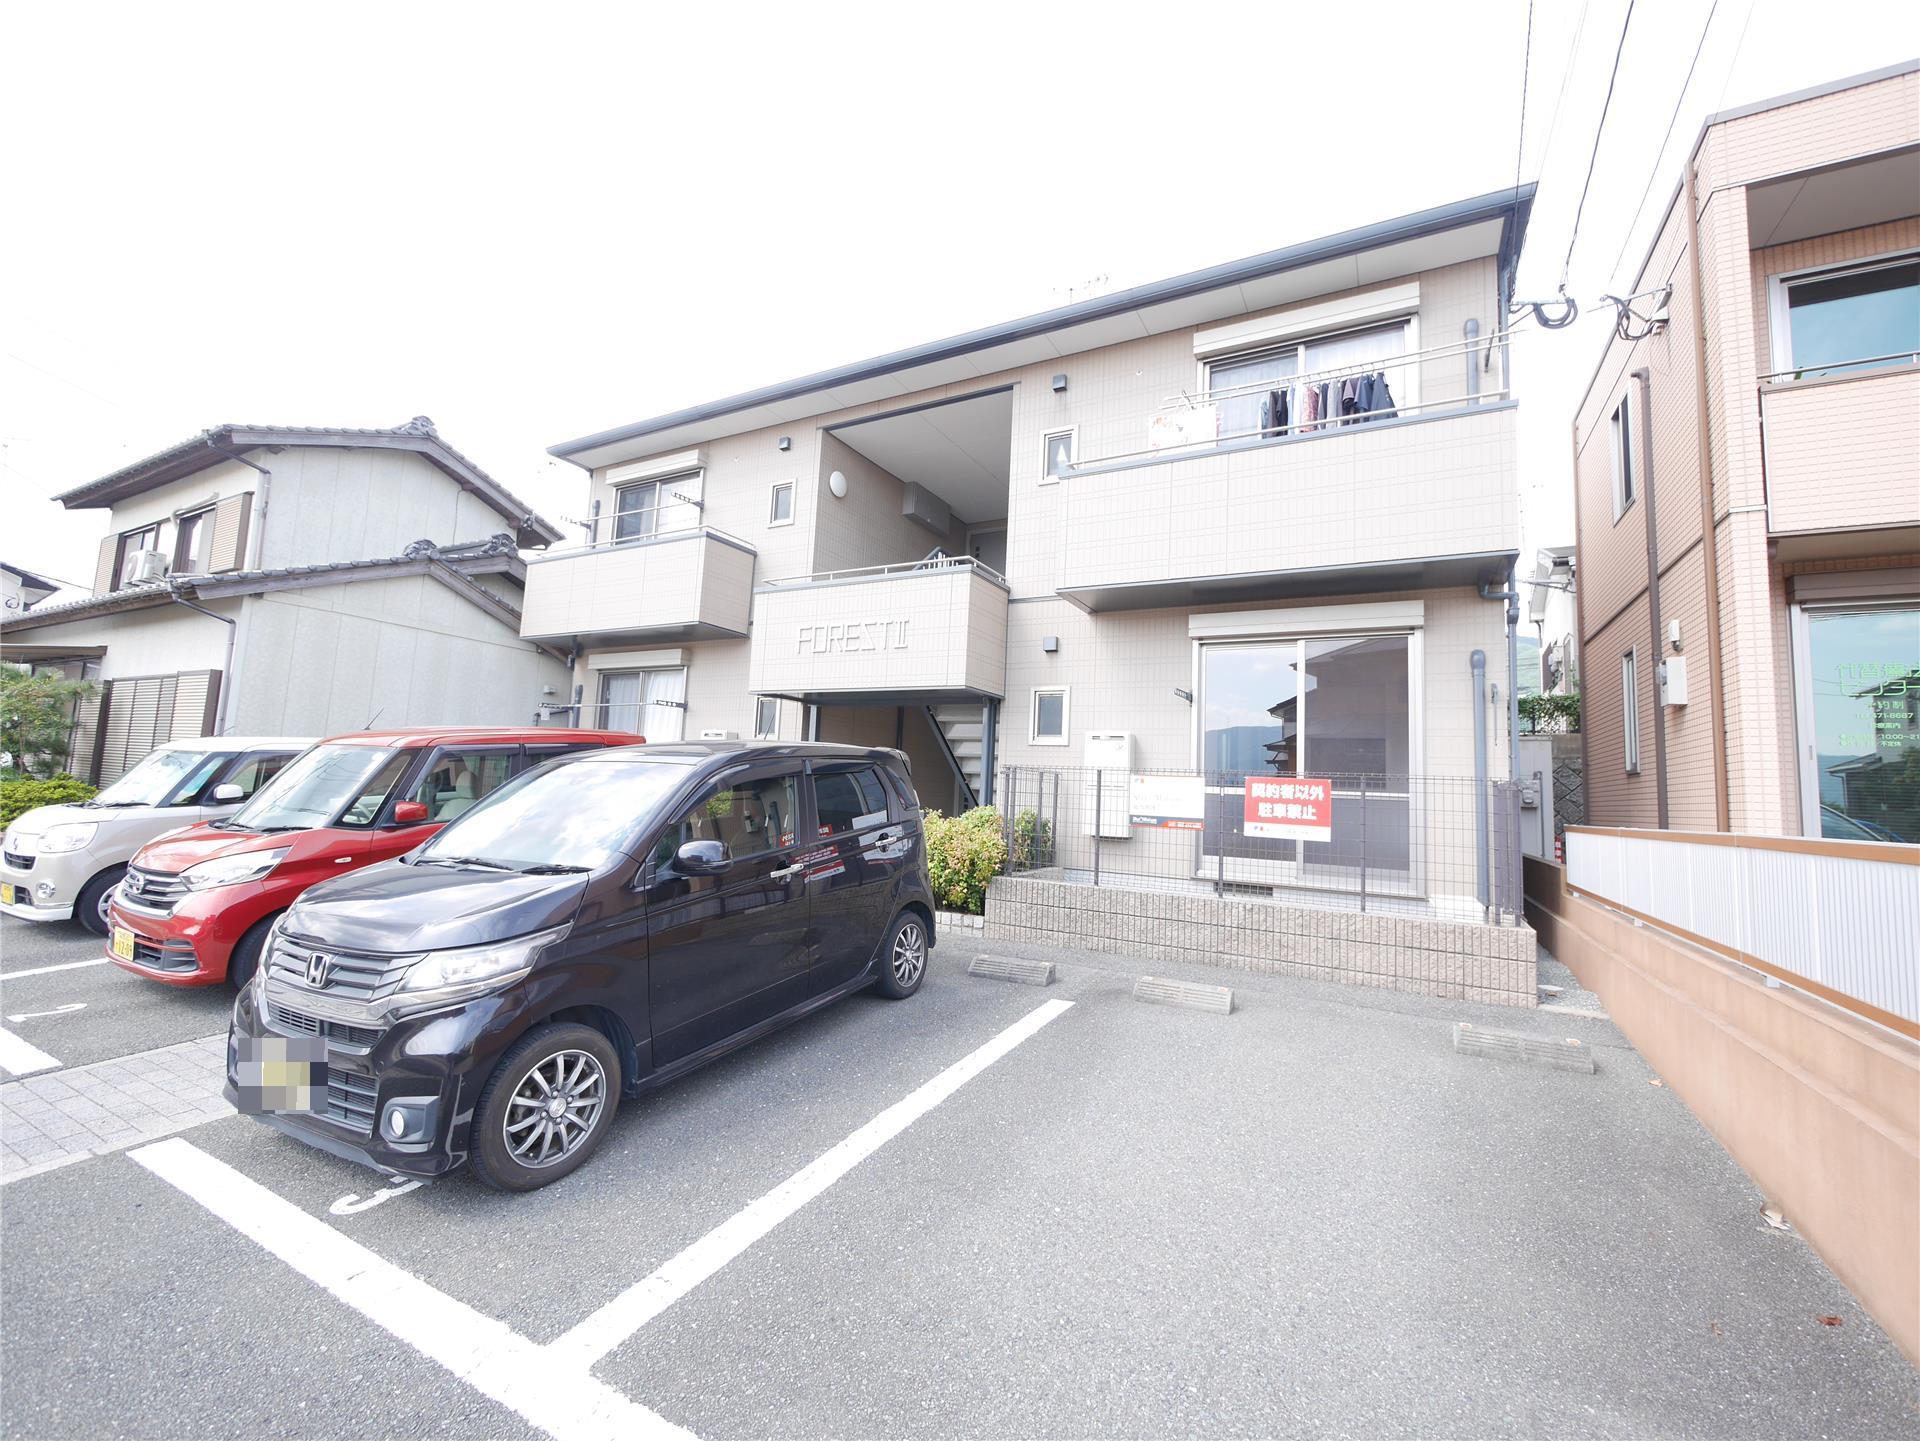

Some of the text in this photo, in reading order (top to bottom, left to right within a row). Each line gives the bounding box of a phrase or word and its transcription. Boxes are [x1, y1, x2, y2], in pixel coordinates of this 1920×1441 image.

[1251, 782, 1325, 801] 契約者以外
[1257, 802, 1317, 821] 駐車禁止
